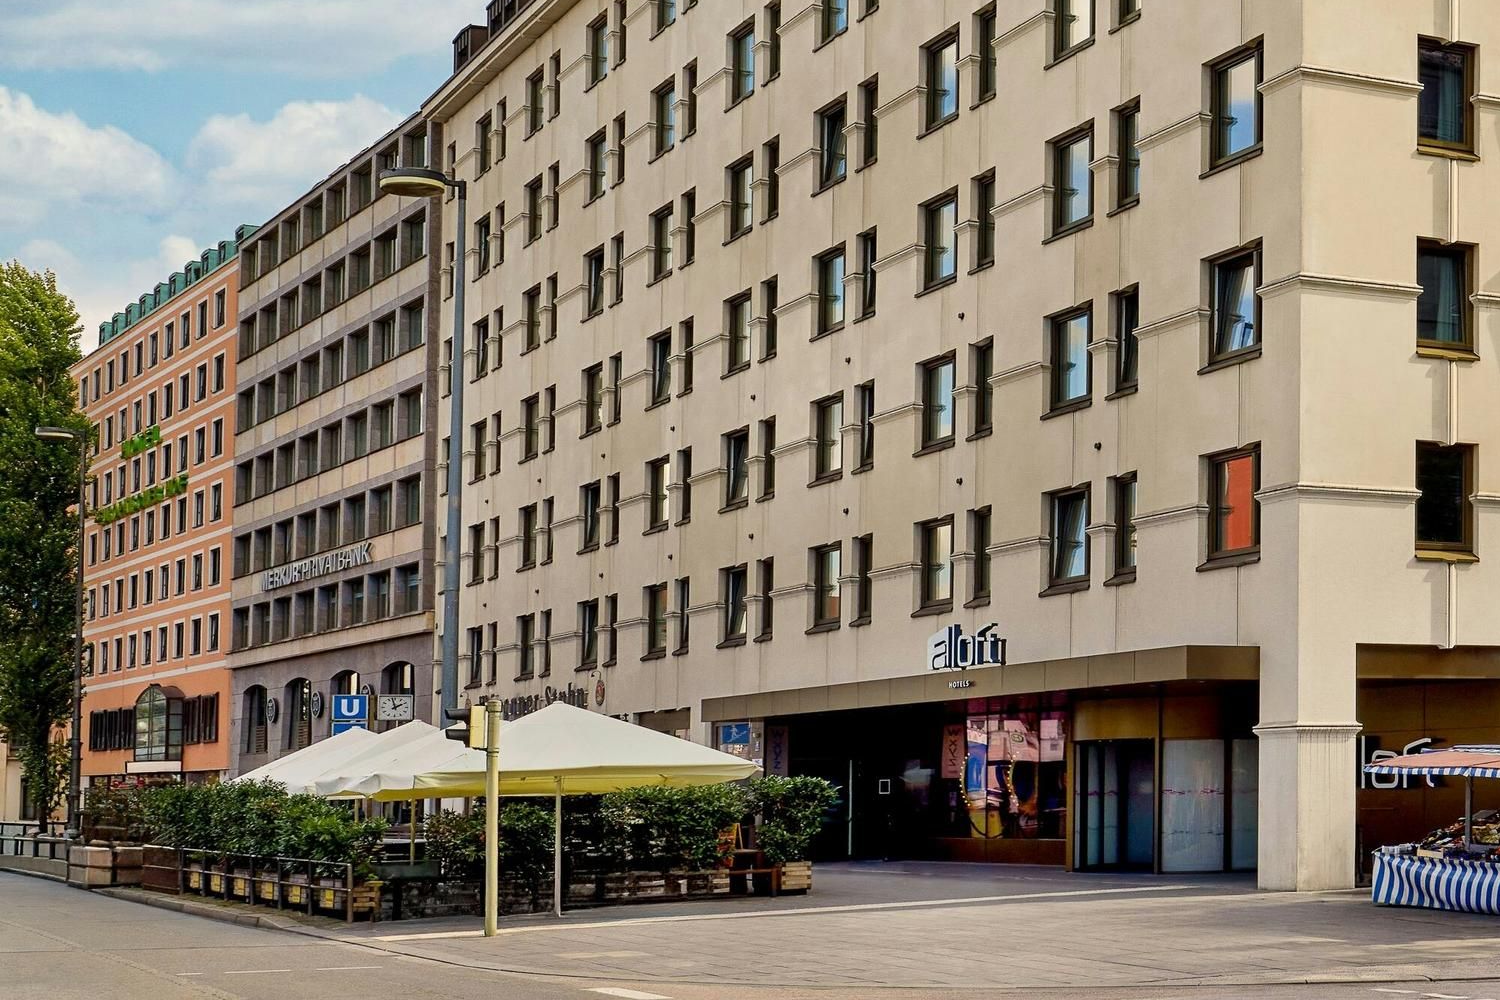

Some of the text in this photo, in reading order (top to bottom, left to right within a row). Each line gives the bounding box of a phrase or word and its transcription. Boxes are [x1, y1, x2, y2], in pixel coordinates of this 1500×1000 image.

[262, 560, 300, 591] MERKUR
[927, 622, 1001, 670] aloft
[948, 680, 969, 689] HOTELS
[341, 698, 360, 716] U
